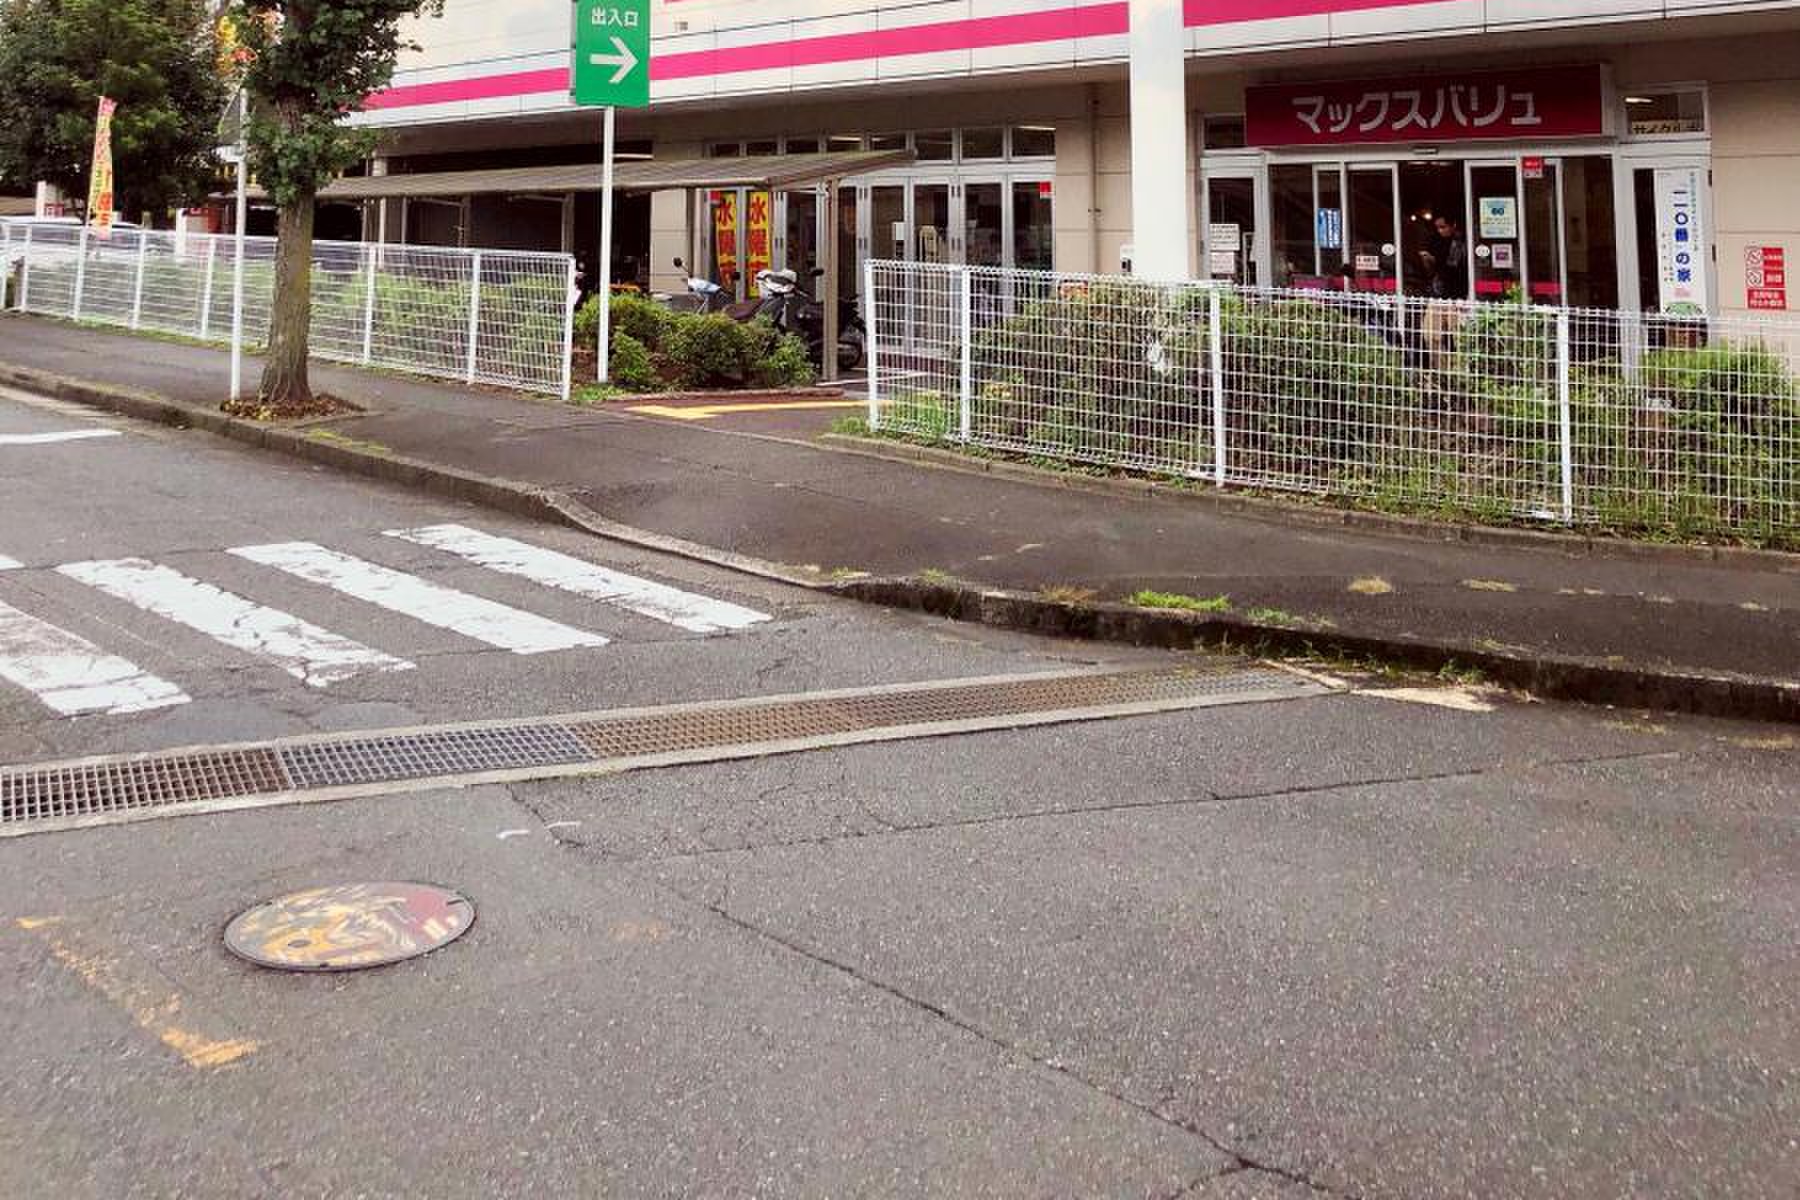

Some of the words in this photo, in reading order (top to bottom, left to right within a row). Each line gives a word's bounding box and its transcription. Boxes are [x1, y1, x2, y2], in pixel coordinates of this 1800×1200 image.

[591, 6, 639, 27] 出入口
[1292, 84, 1542, 134] マックスバリュ
